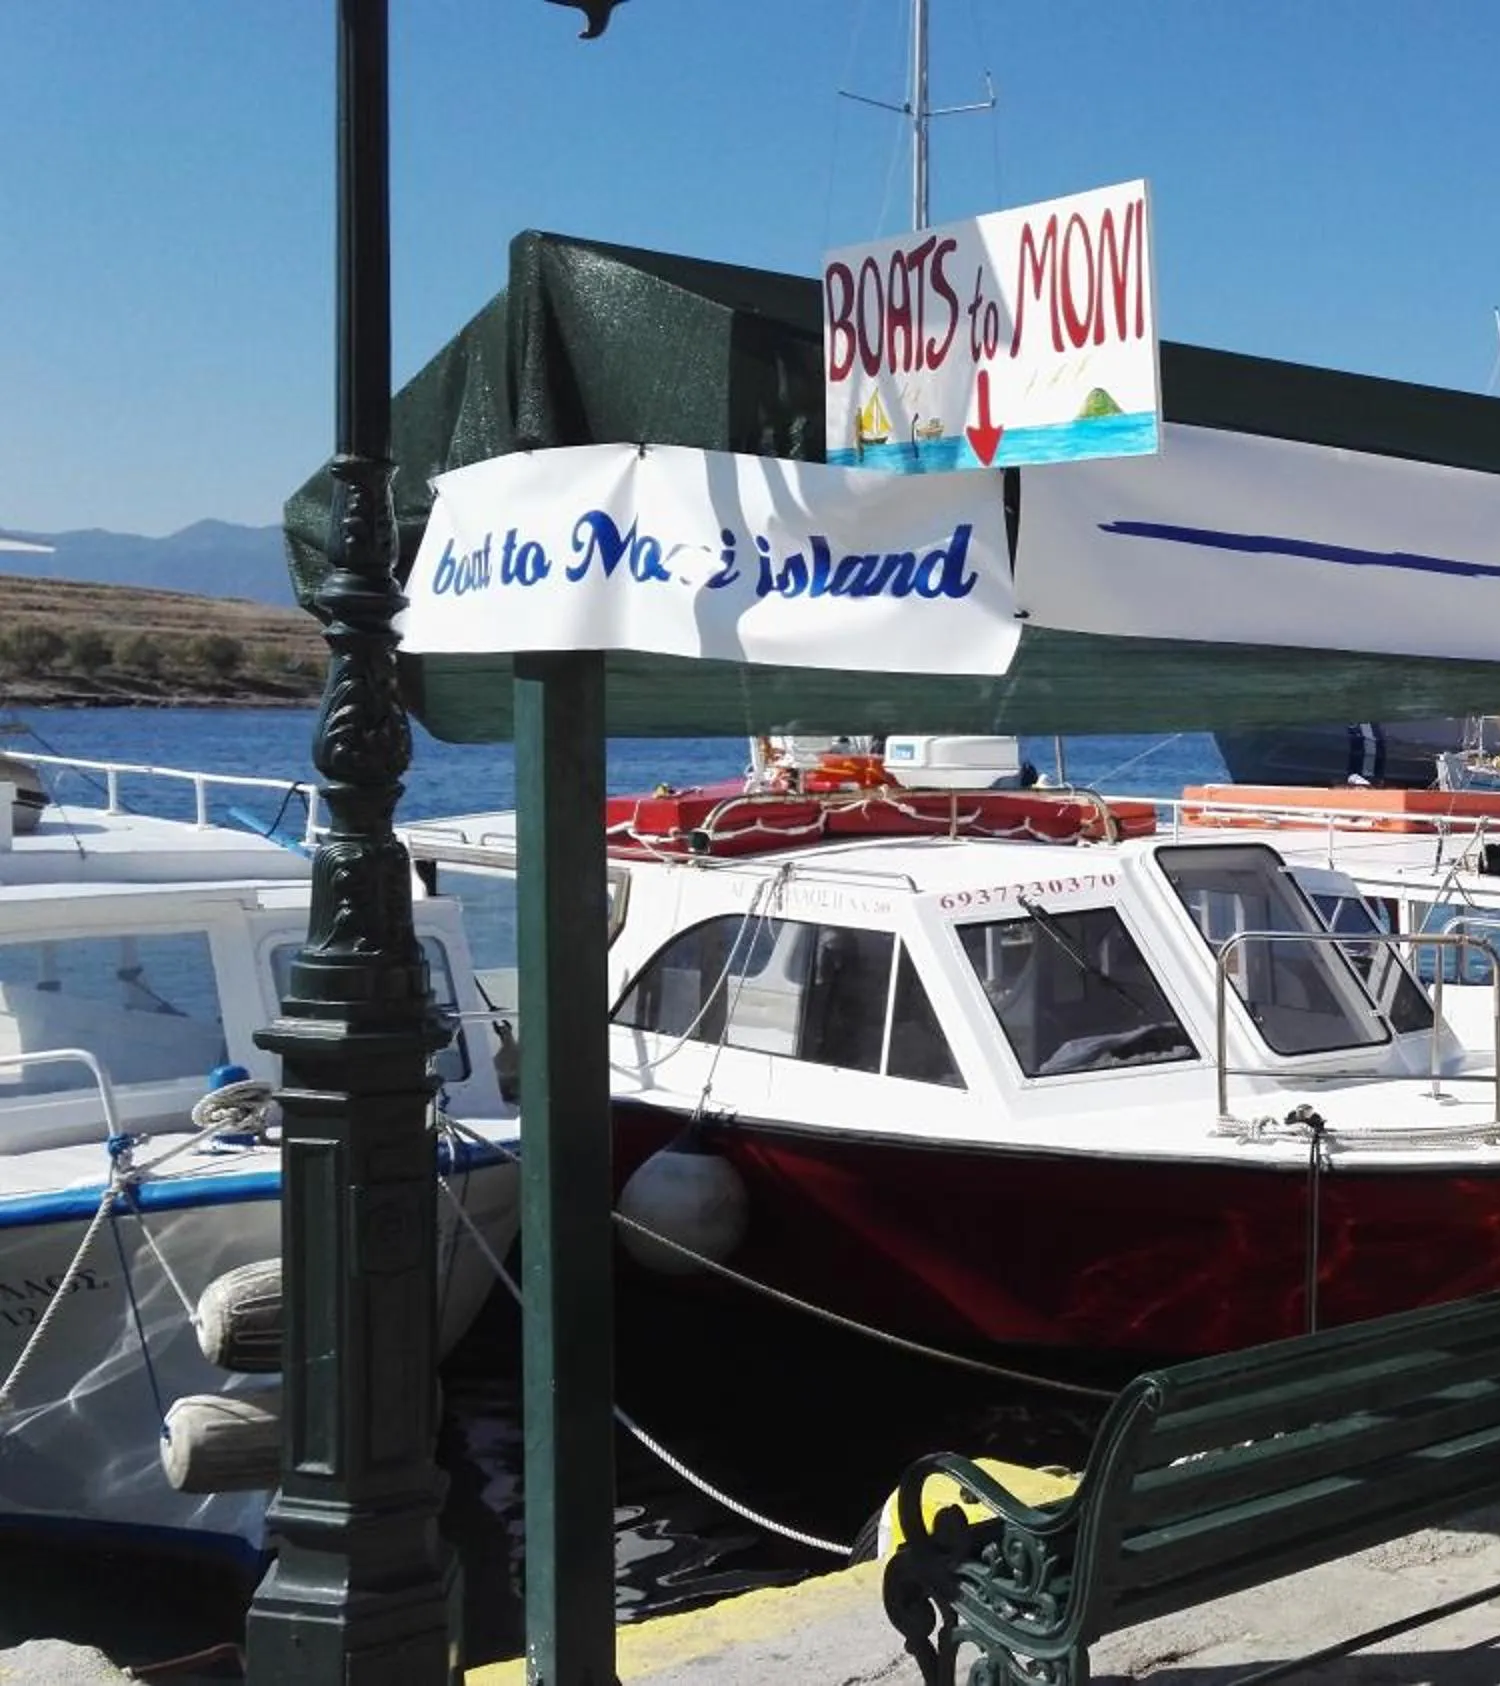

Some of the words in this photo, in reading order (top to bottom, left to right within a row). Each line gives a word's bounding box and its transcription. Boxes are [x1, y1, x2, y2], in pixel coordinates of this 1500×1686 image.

[826, 235, 959, 382] BOATS
[968, 264, 998, 362] to
[1010, 198, 1145, 358] MONI
[432, 537, 493, 597] boat
[501, 527, 552, 586] to
[755, 524, 979, 599] island
[939, 872, 1116, 910] 6937230370
